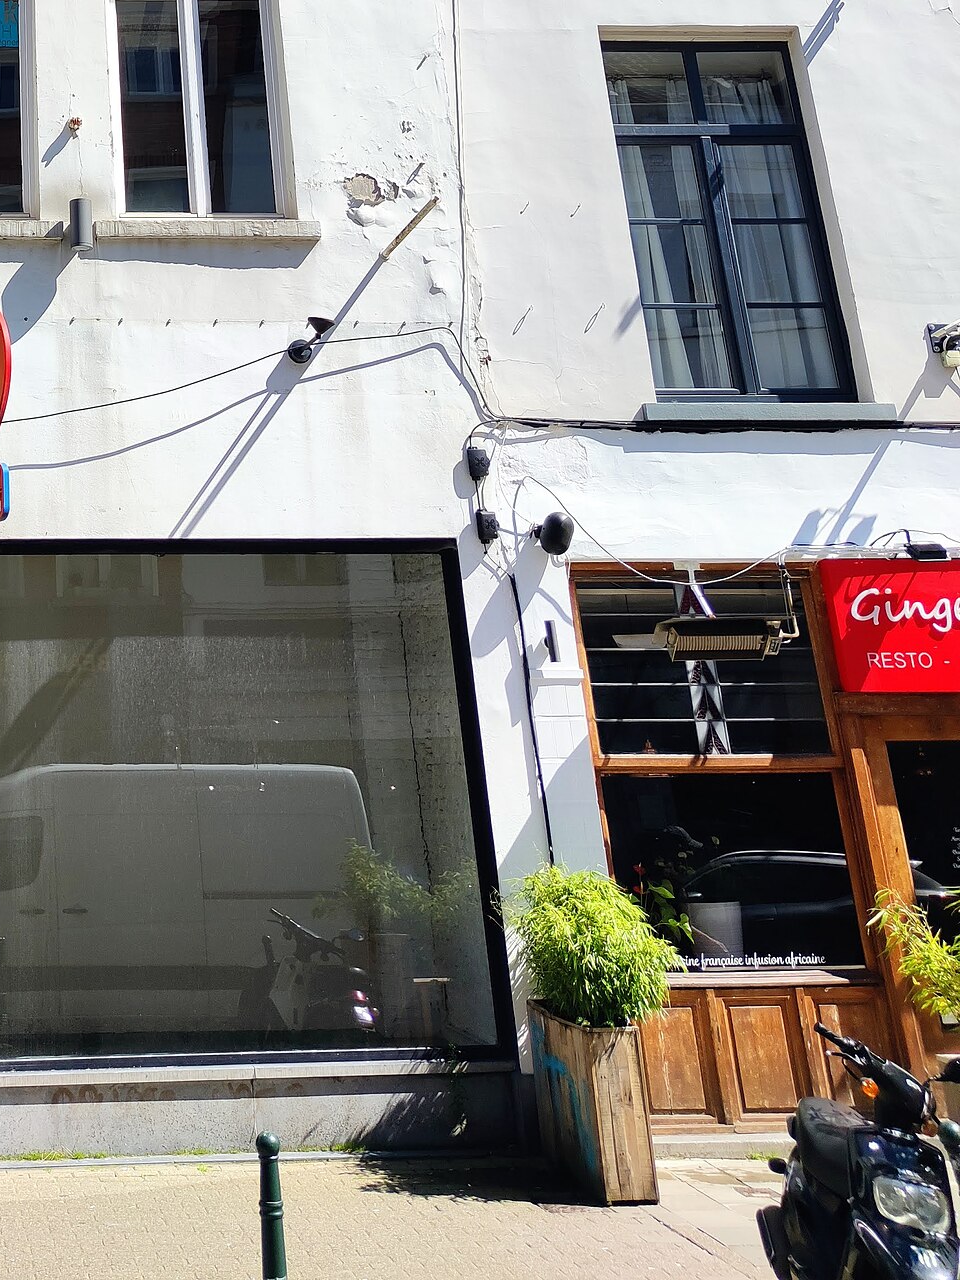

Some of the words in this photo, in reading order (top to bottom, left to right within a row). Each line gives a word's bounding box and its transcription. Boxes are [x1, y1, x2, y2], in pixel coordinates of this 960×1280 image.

[867, 652, 933, 669] RESTO
[701, 952, 744, 971] française
[745, 951, 784, 969] infusion
[785, 951, 826, 969] africaine
